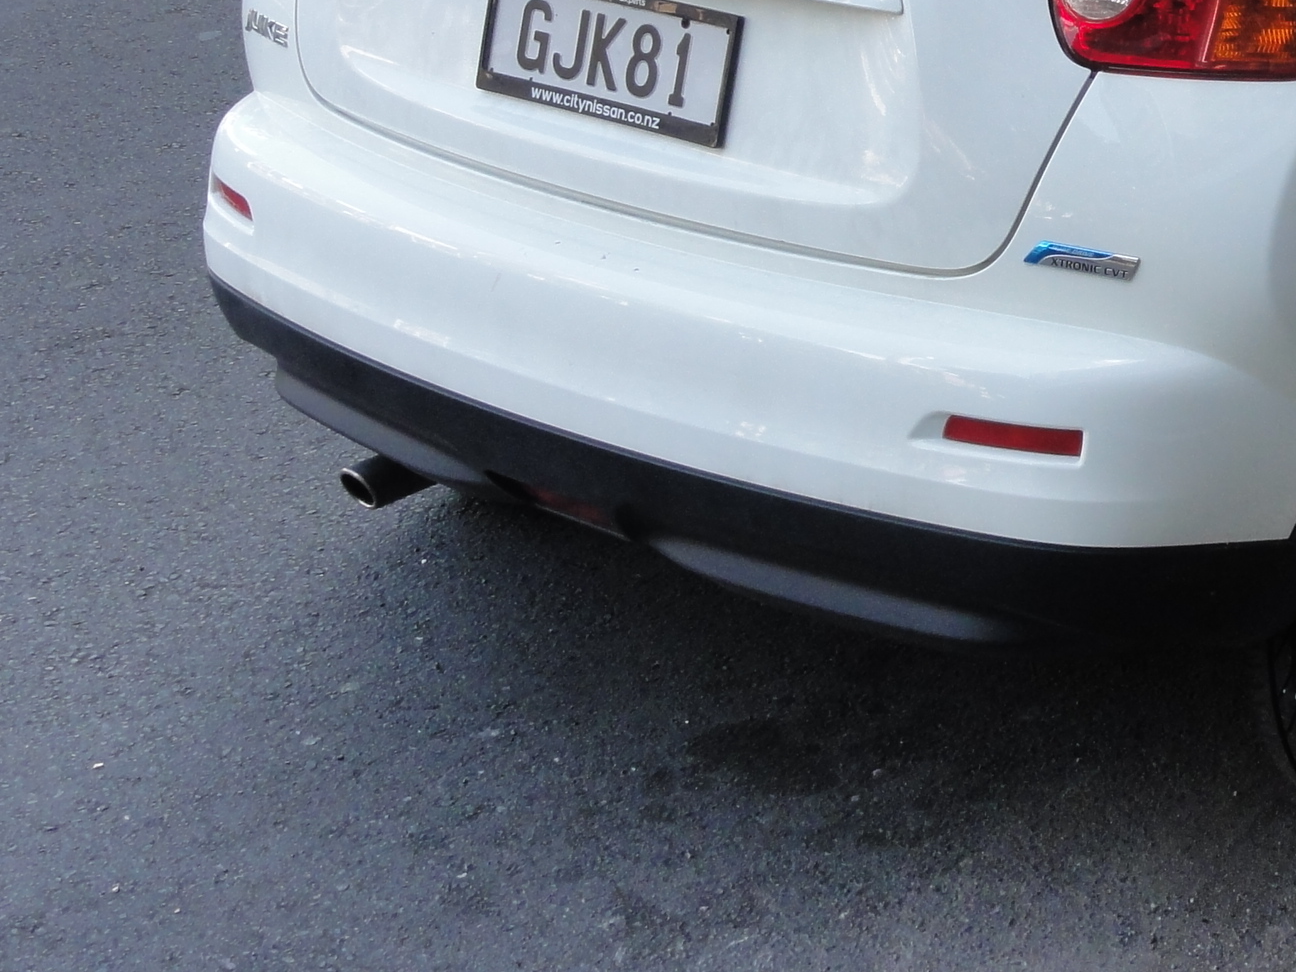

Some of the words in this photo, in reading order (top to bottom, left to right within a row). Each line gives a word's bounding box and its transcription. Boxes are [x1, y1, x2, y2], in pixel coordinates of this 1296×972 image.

[245, 8, 289, 48] JUKE
[530, 86, 661, 130] www.citynissan.co.nz
[1050, 257, 1102, 275] XTRONIC
[1104, 267, 1129, 279] CVT
